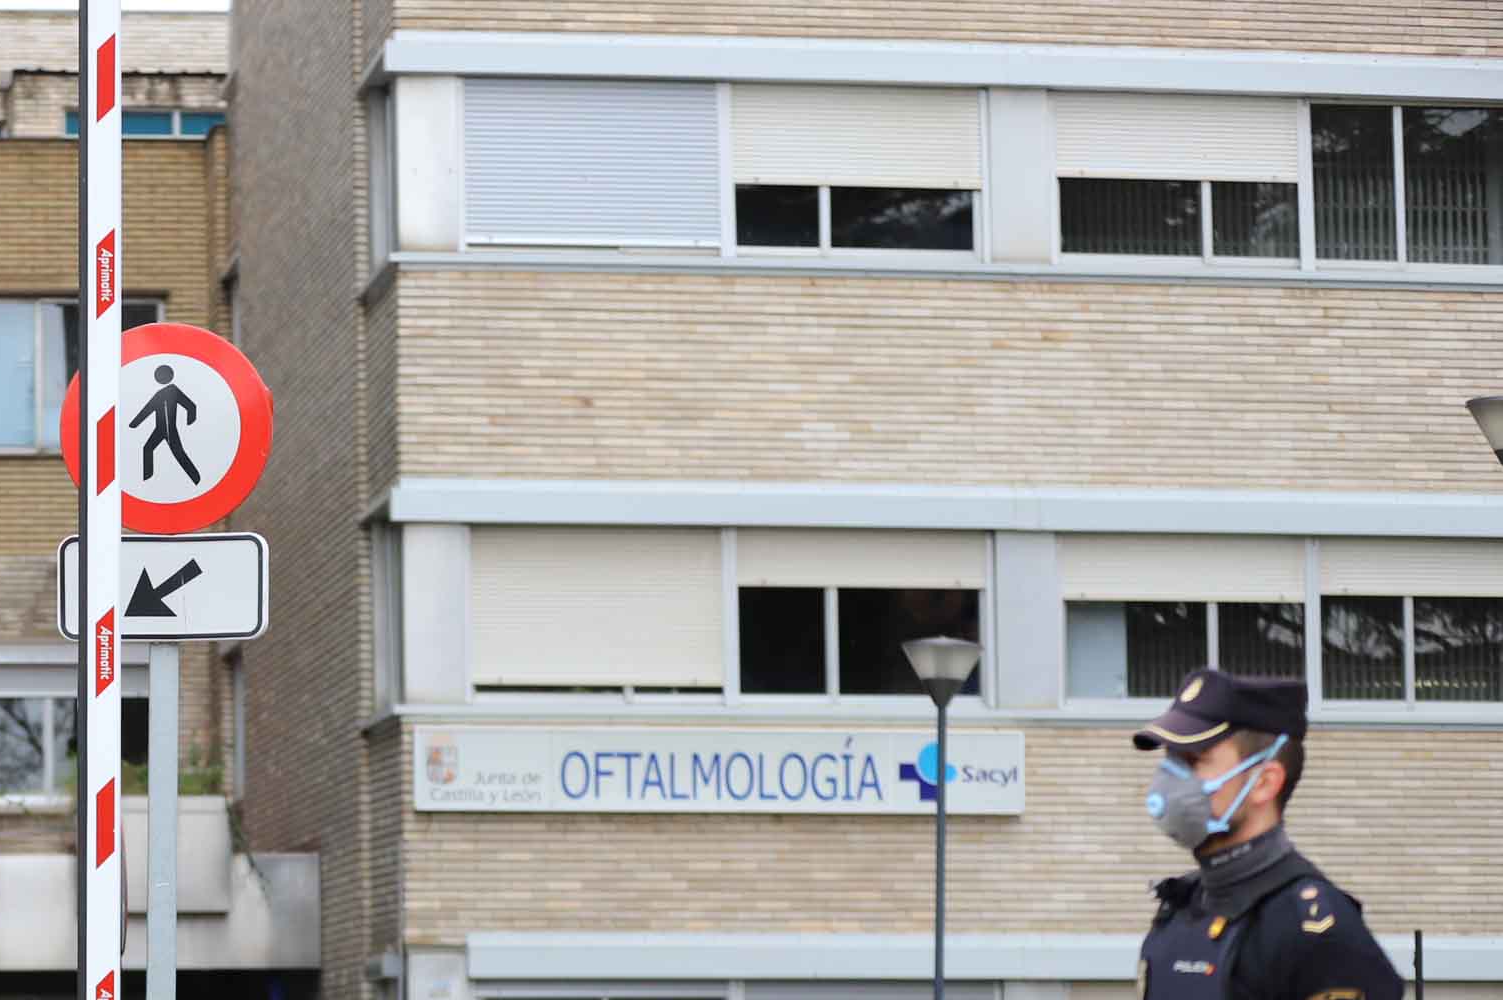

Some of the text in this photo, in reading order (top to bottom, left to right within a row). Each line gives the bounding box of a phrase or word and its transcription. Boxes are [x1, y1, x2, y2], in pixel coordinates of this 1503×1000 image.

[99, 247, 113, 302] Aprimatic
[99, 626, 113, 680] Aprimatic
[473, 770, 543, 785] Junta de
[559, 735, 884, 802] OFTALMOLOGÍA
[962, 764, 1018, 787] Sacyl
[429, 787, 485, 801] Castilla
[502, 787, 543, 802] León
